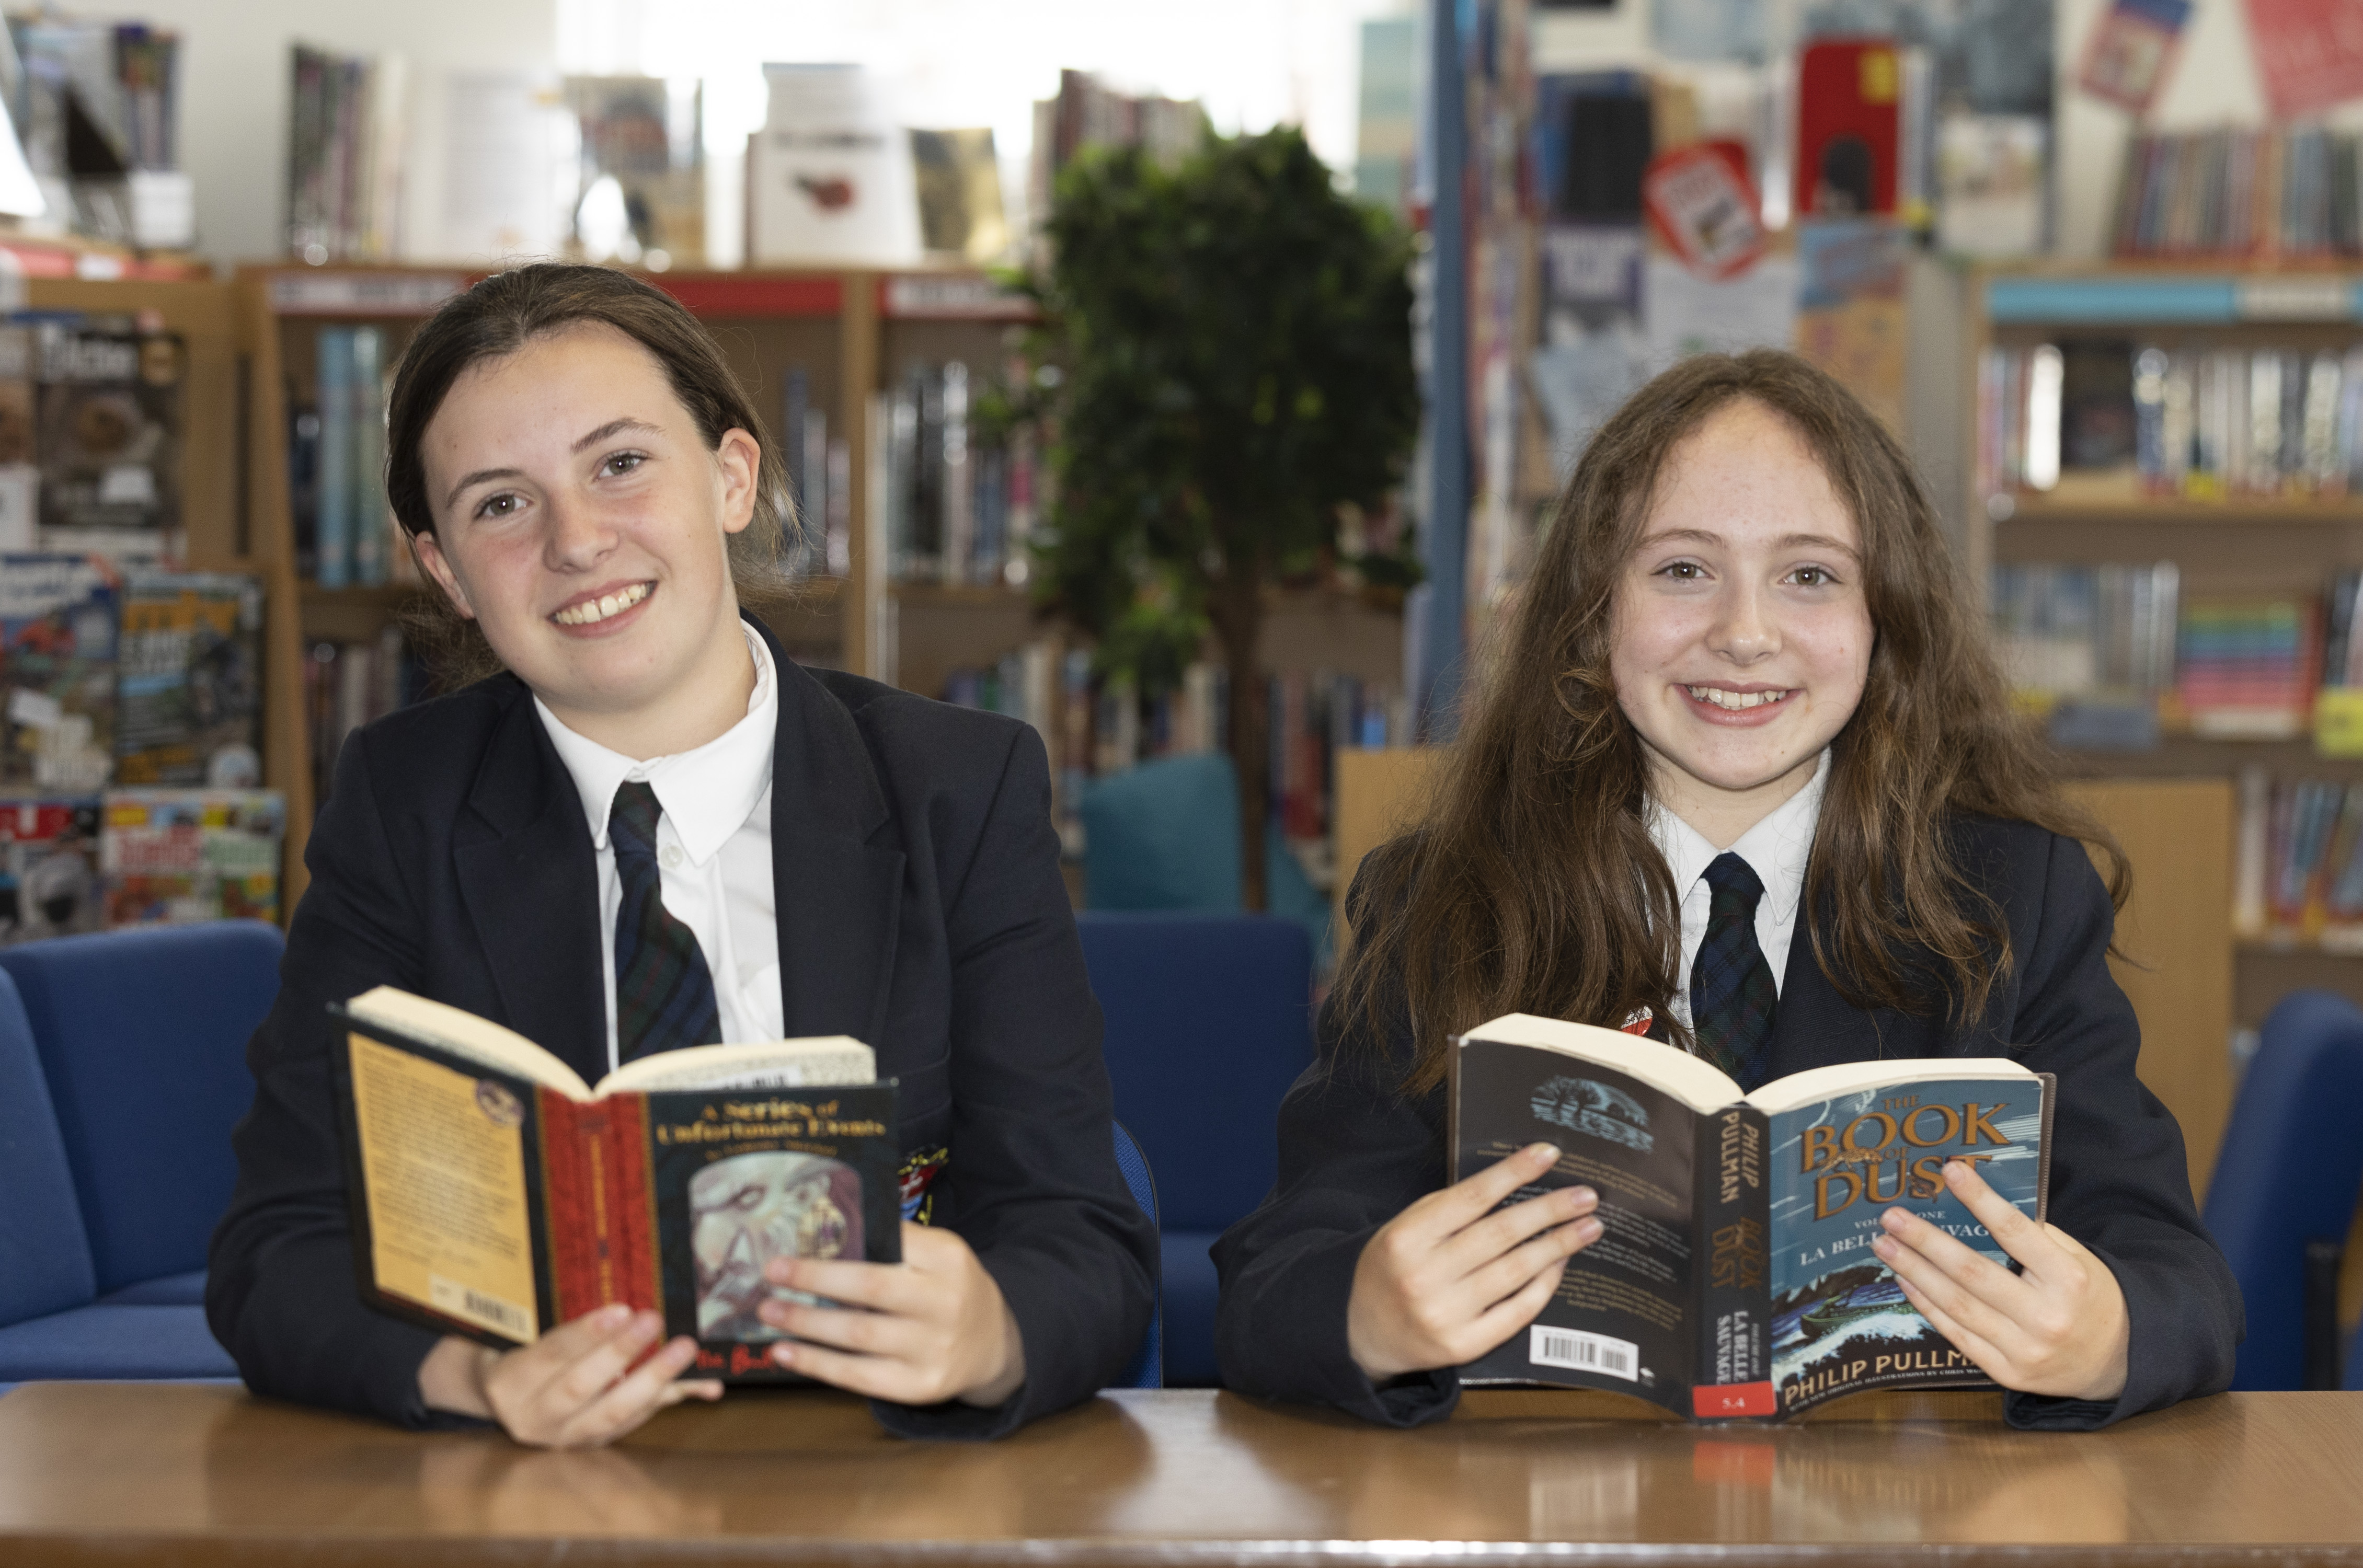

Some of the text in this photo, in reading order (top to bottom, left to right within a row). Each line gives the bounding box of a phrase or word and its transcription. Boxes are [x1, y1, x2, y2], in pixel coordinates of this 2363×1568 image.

[1882, 1096, 1920, 1112] THE
[1721, 1111, 1741, 1204] PULLMAN
[1741, 1122, 1760, 1189] PHILIP
[1800, 1102, 2012, 1174] BOOK
[1885, 1147, 1911, 1161] OF
[1800, 1229, 1891, 1266] LA BELL
[1716, 1315, 1732, 1385] SAUVAGE
[1733, 1310, 1749, 1383] LA BELLE
[1722, 1392, 1746, 1409] 5.4
[1784, 1350, 1974, 1406] PHILIP PULLM
